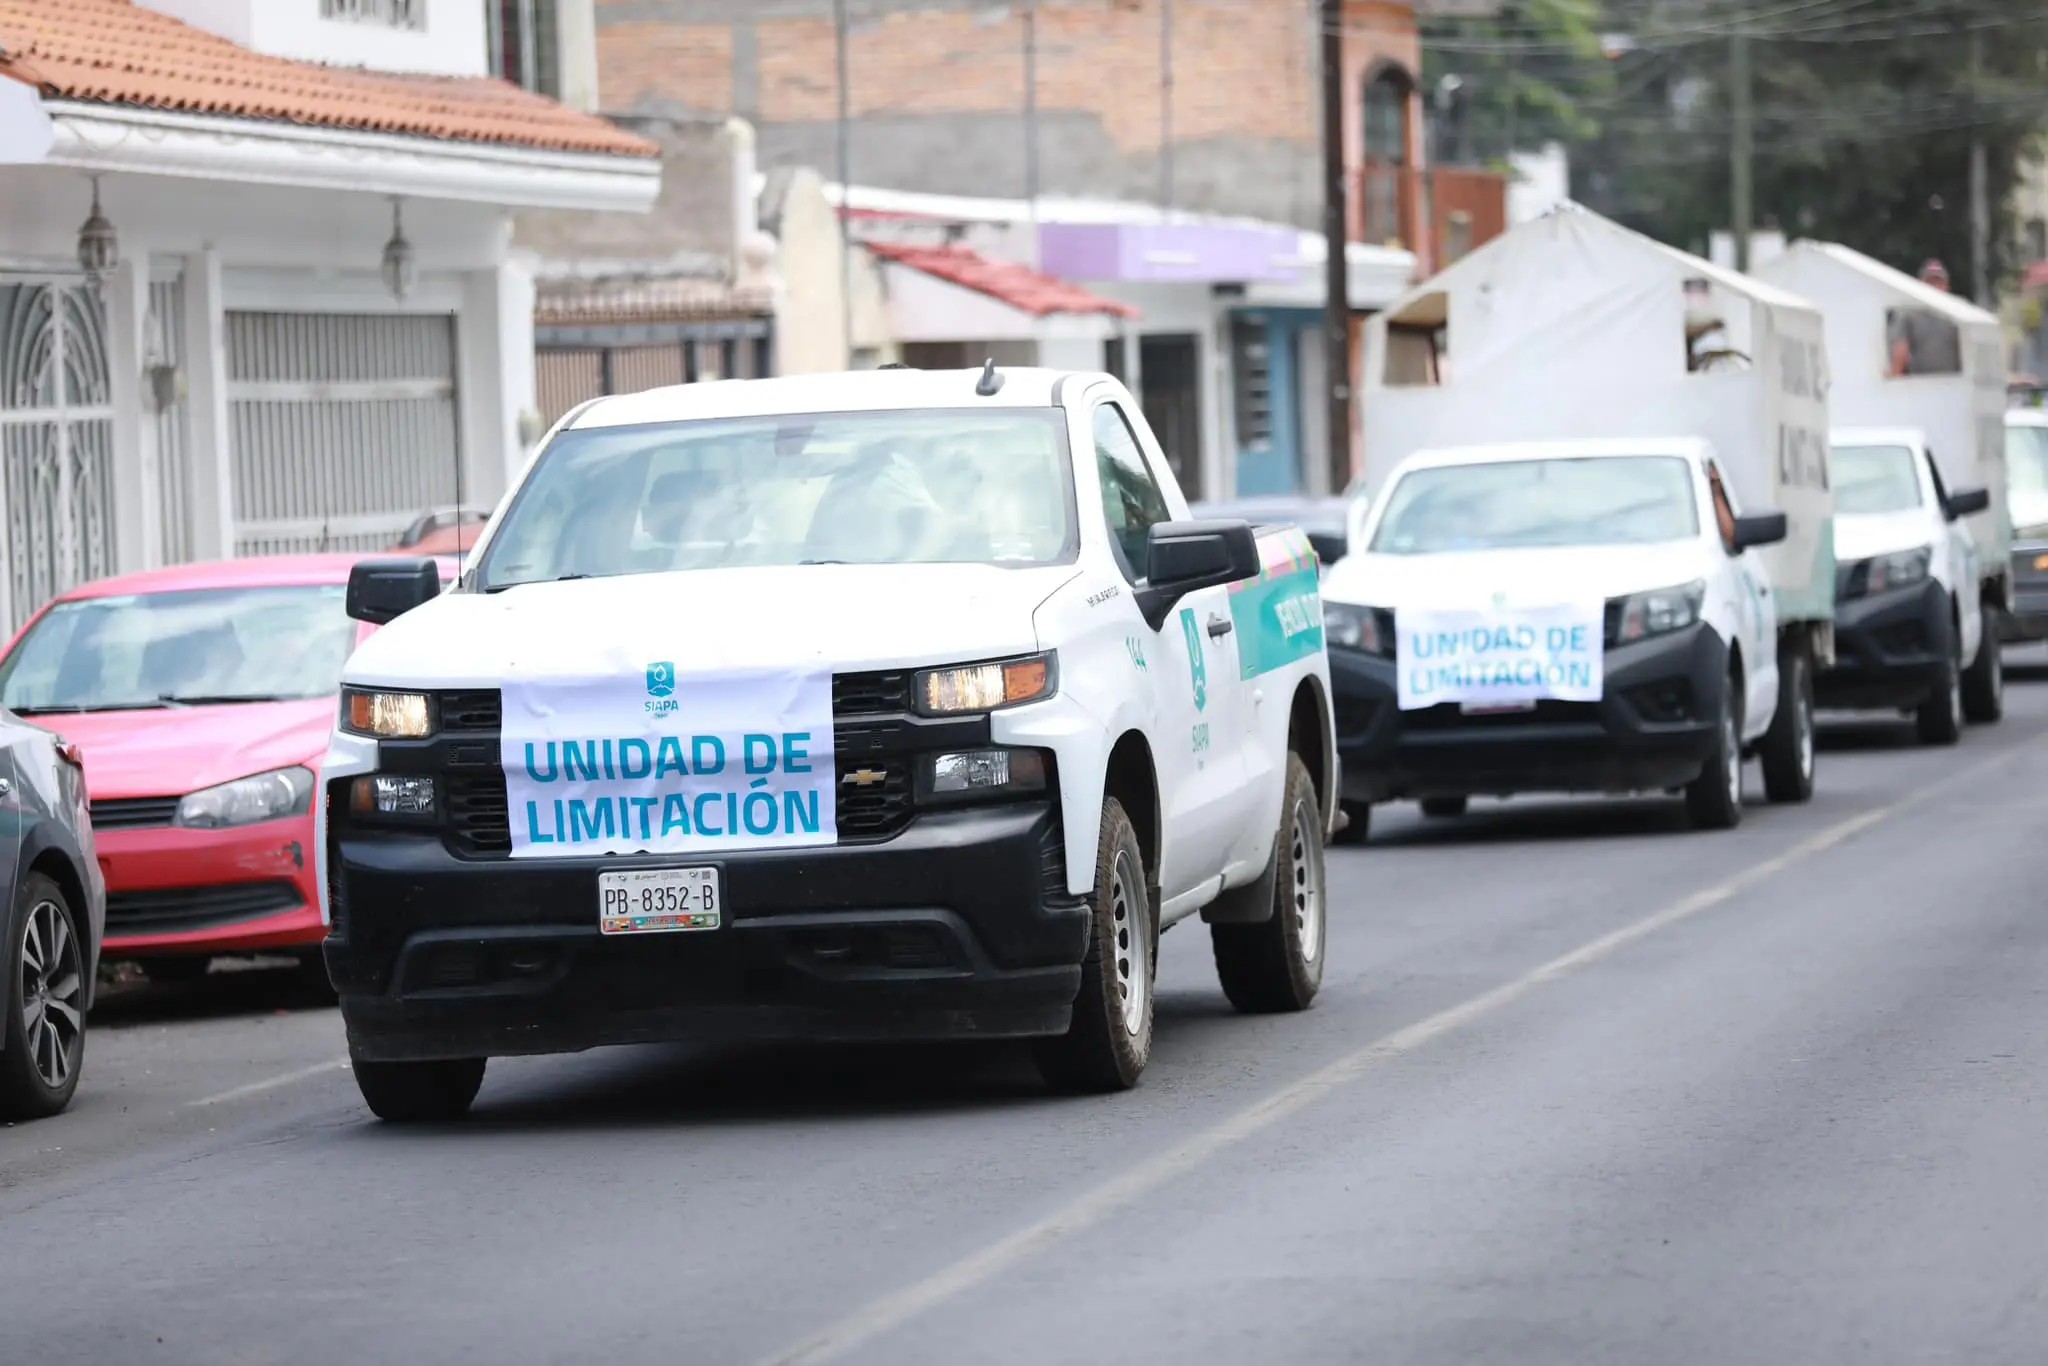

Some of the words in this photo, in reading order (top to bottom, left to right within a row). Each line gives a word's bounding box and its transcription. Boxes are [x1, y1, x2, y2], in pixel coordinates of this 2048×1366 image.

[1412, 625, 1536, 658] UNIDAD
[1546, 624, 1589, 653] DE
[644, 700, 679, 712] SIAPA
[525, 735, 725, 783] UNIDAD
[743, 732, 812, 775] DE
[527, 777, 820, 843] LIMITACIÓN
[605, 884, 714, 915] PB-8352-B
